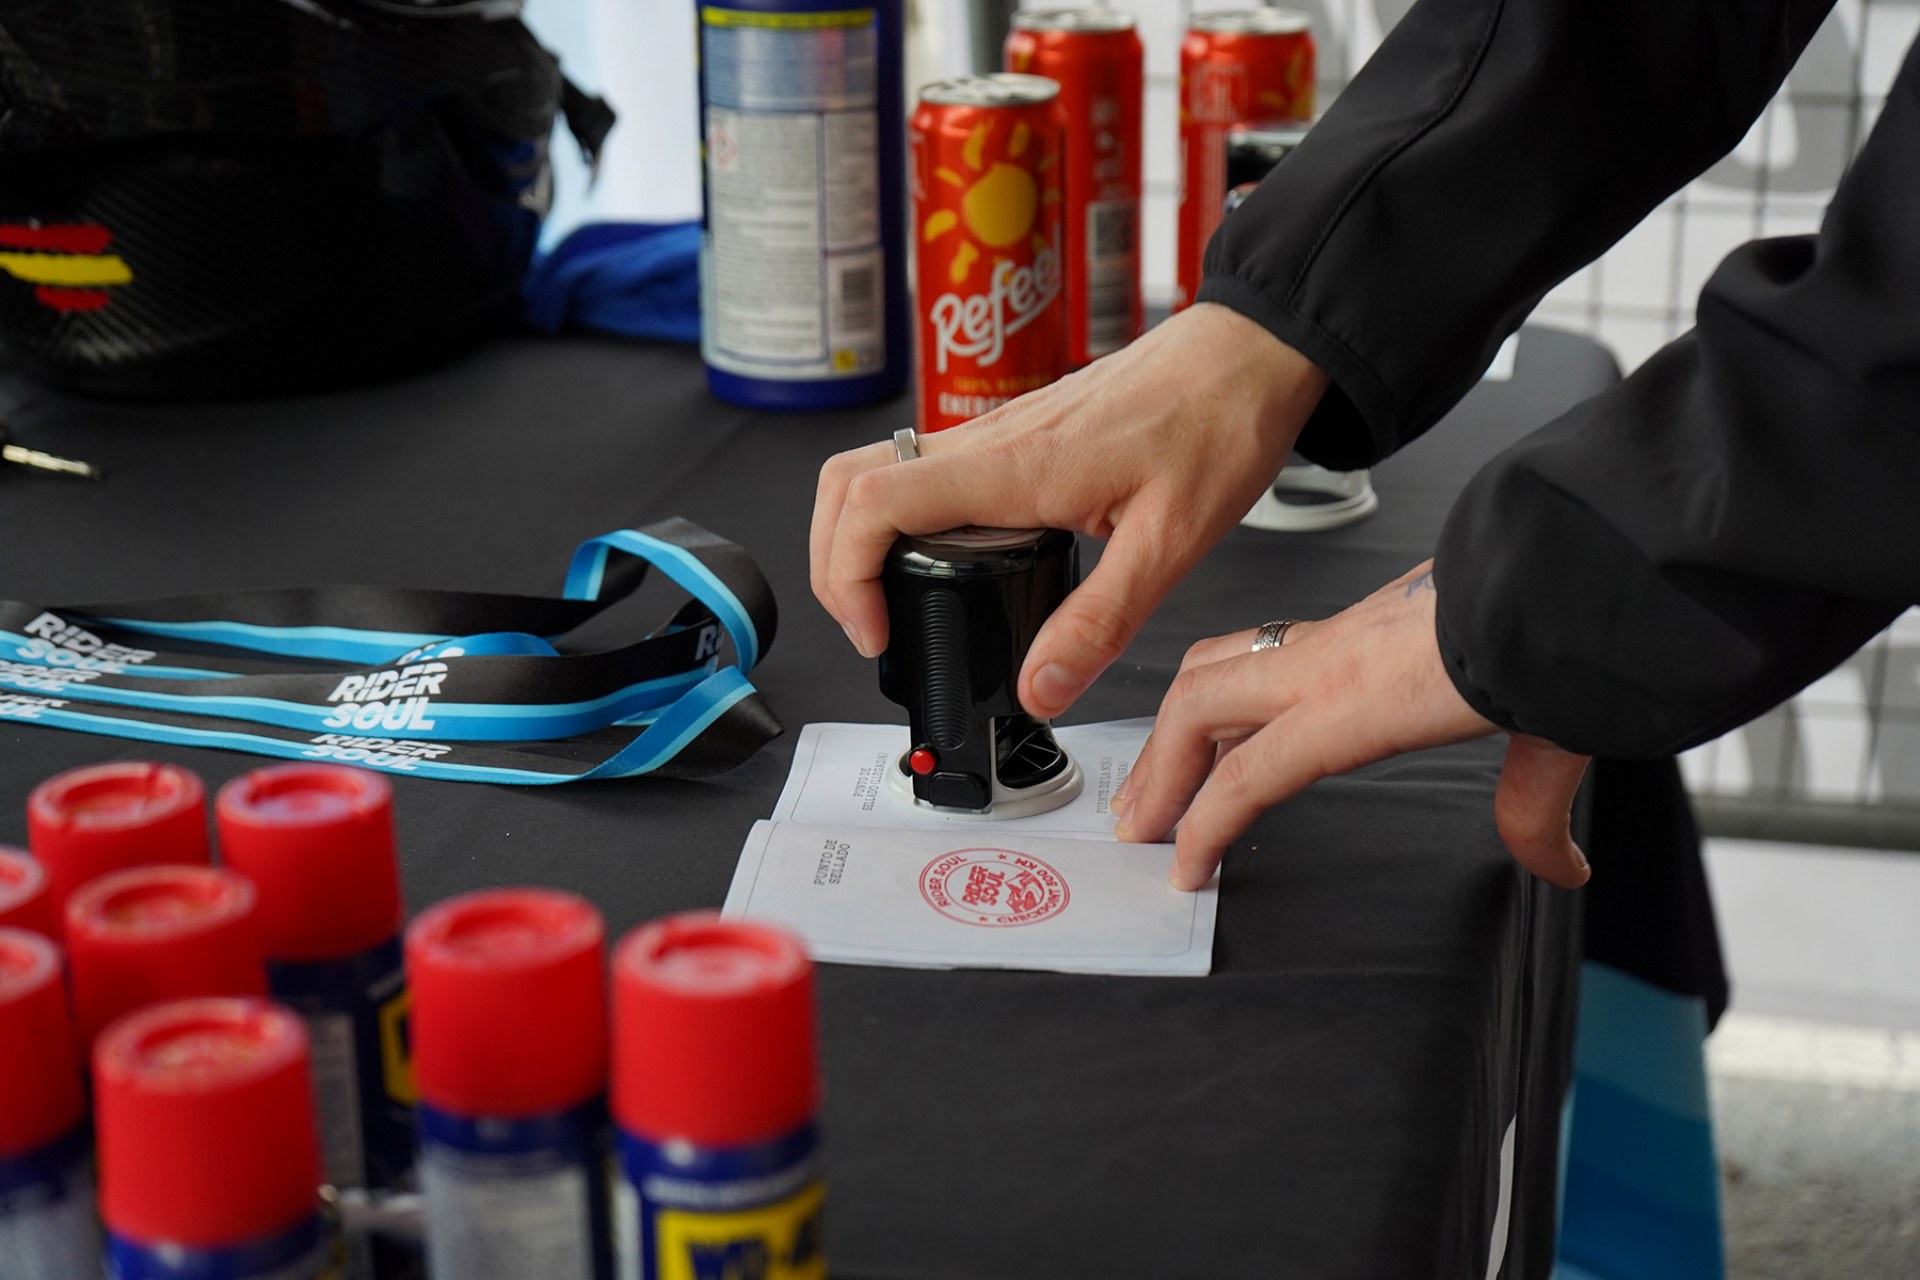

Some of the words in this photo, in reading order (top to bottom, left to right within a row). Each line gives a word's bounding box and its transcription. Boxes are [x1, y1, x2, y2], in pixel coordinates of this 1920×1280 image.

[24, 611, 158, 664] RIDER
[15, 637, 126, 674] SOUL
[327, 661, 449, 702] RIDER
[321, 696, 436, 731] SOUL
[301, 744, 422, 771] SOUL
[310, 733, 452, 759] RIDER
[853, 777, 869, 797] PUNTO
[862, 785, 879, 811] SELLADO
[813, 851, 834, 885] PUNTO
[824, 839, 838, 851] DE
[829, 843, 850, 885] SELLADO
[933, 855, 968, 876] SOUL
[929, 877, 950, 907] RIDER
[962, 865, 988, 906] RIDER
[980, 871, 1005, 906] SOUL
[997, 888, 1061, 923] CHECKPOINT
